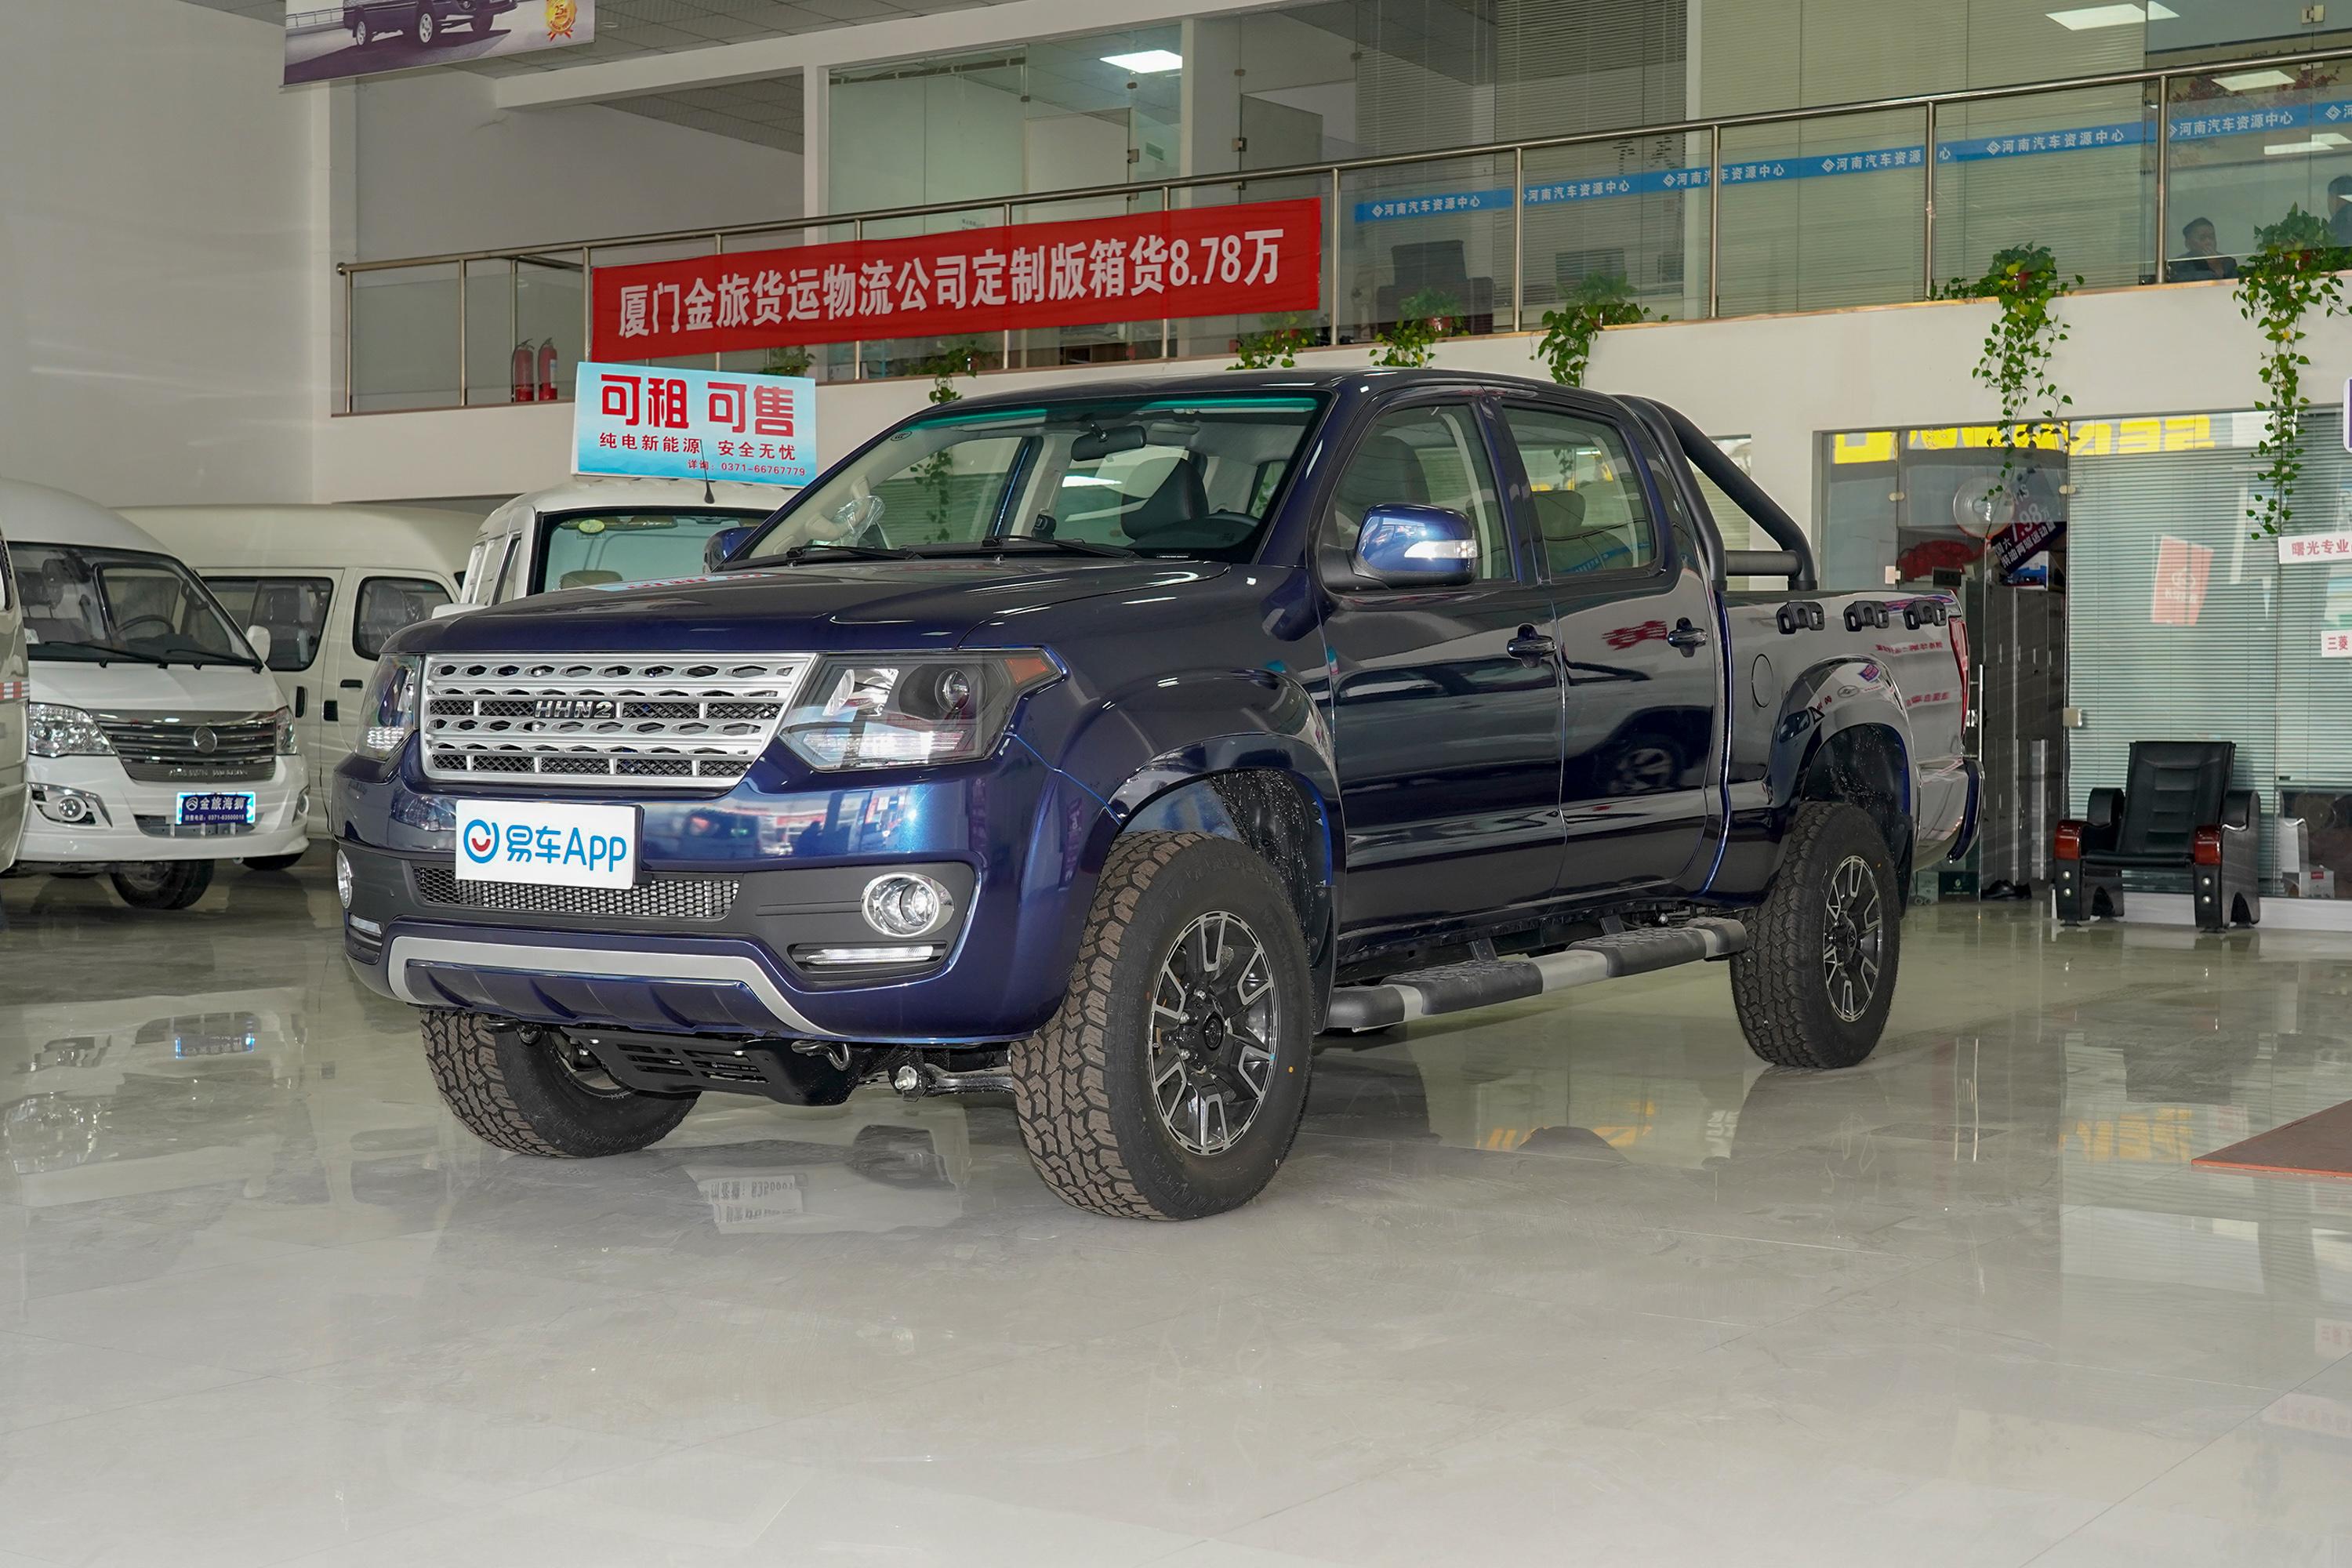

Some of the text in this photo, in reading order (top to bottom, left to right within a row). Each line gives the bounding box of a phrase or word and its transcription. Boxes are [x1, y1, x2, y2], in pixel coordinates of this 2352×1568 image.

[2180, 111, 2293, 136] 河南汽车资源中心
[2002, 129, 2124, 153] 河南汽车资源中心
[1836, 147, 1951, 170] 河南汽车资源心
[1529, 180, 1630, 201] 河南汽车资源中心
[1385, 196, 1480, 216] 河南汽车资源中心
[619, 229, 1283, 339] 厦门金旅货运物流公司定制版箱货8.78万
[601, 374, 794, 437] 可租 可售
[600, 433, 796, 461] 纯电新能源 安全无忧
[721, 463, 805, 476] 0371-66767779
[2292, 539, 2352, 557] 曙光专业
[535, 700, 612, 718] HHN2
[200, 797, 245, 811] 金旅海狮
[506, 825, 627, 873] 易车App
